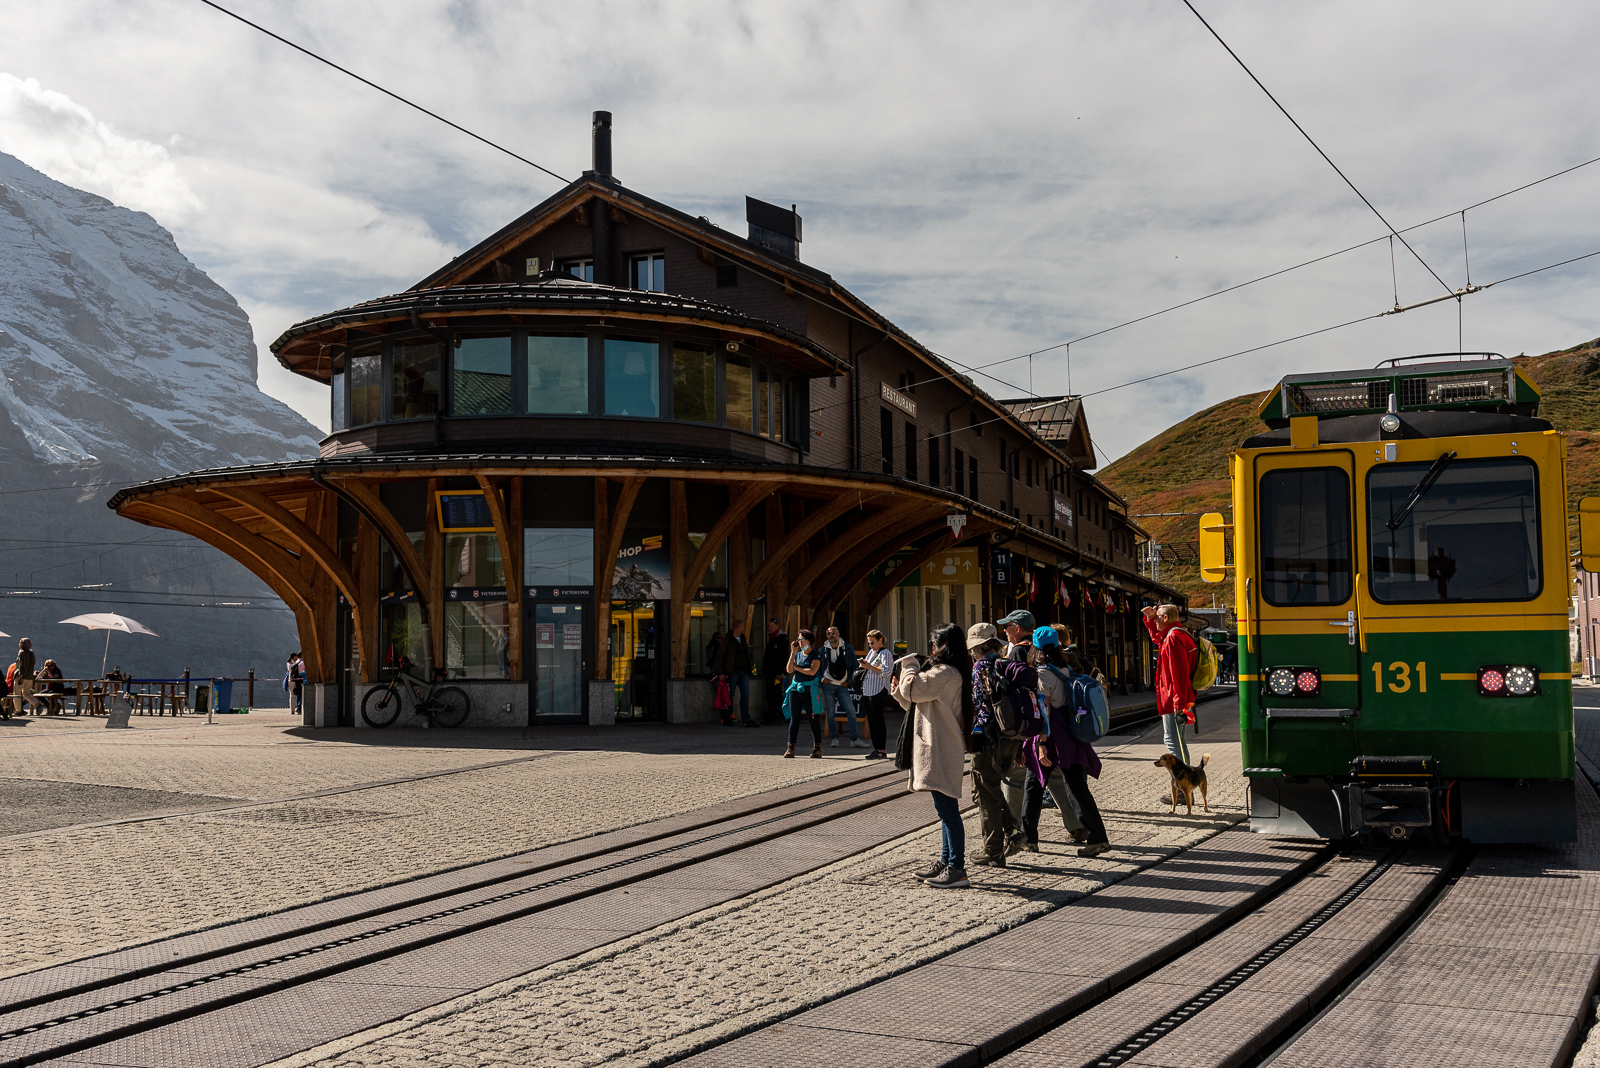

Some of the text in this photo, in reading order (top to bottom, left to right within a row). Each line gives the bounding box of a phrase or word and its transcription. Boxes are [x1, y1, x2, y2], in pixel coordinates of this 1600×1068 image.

[883, 386, 915, 414] RESTAURANT
[997, 554, 1006, 564] 11
[997, 571, 1006, 581] B
[1372, 661, 1427, 693] 131
[849, 693, 863, 701] TRY
